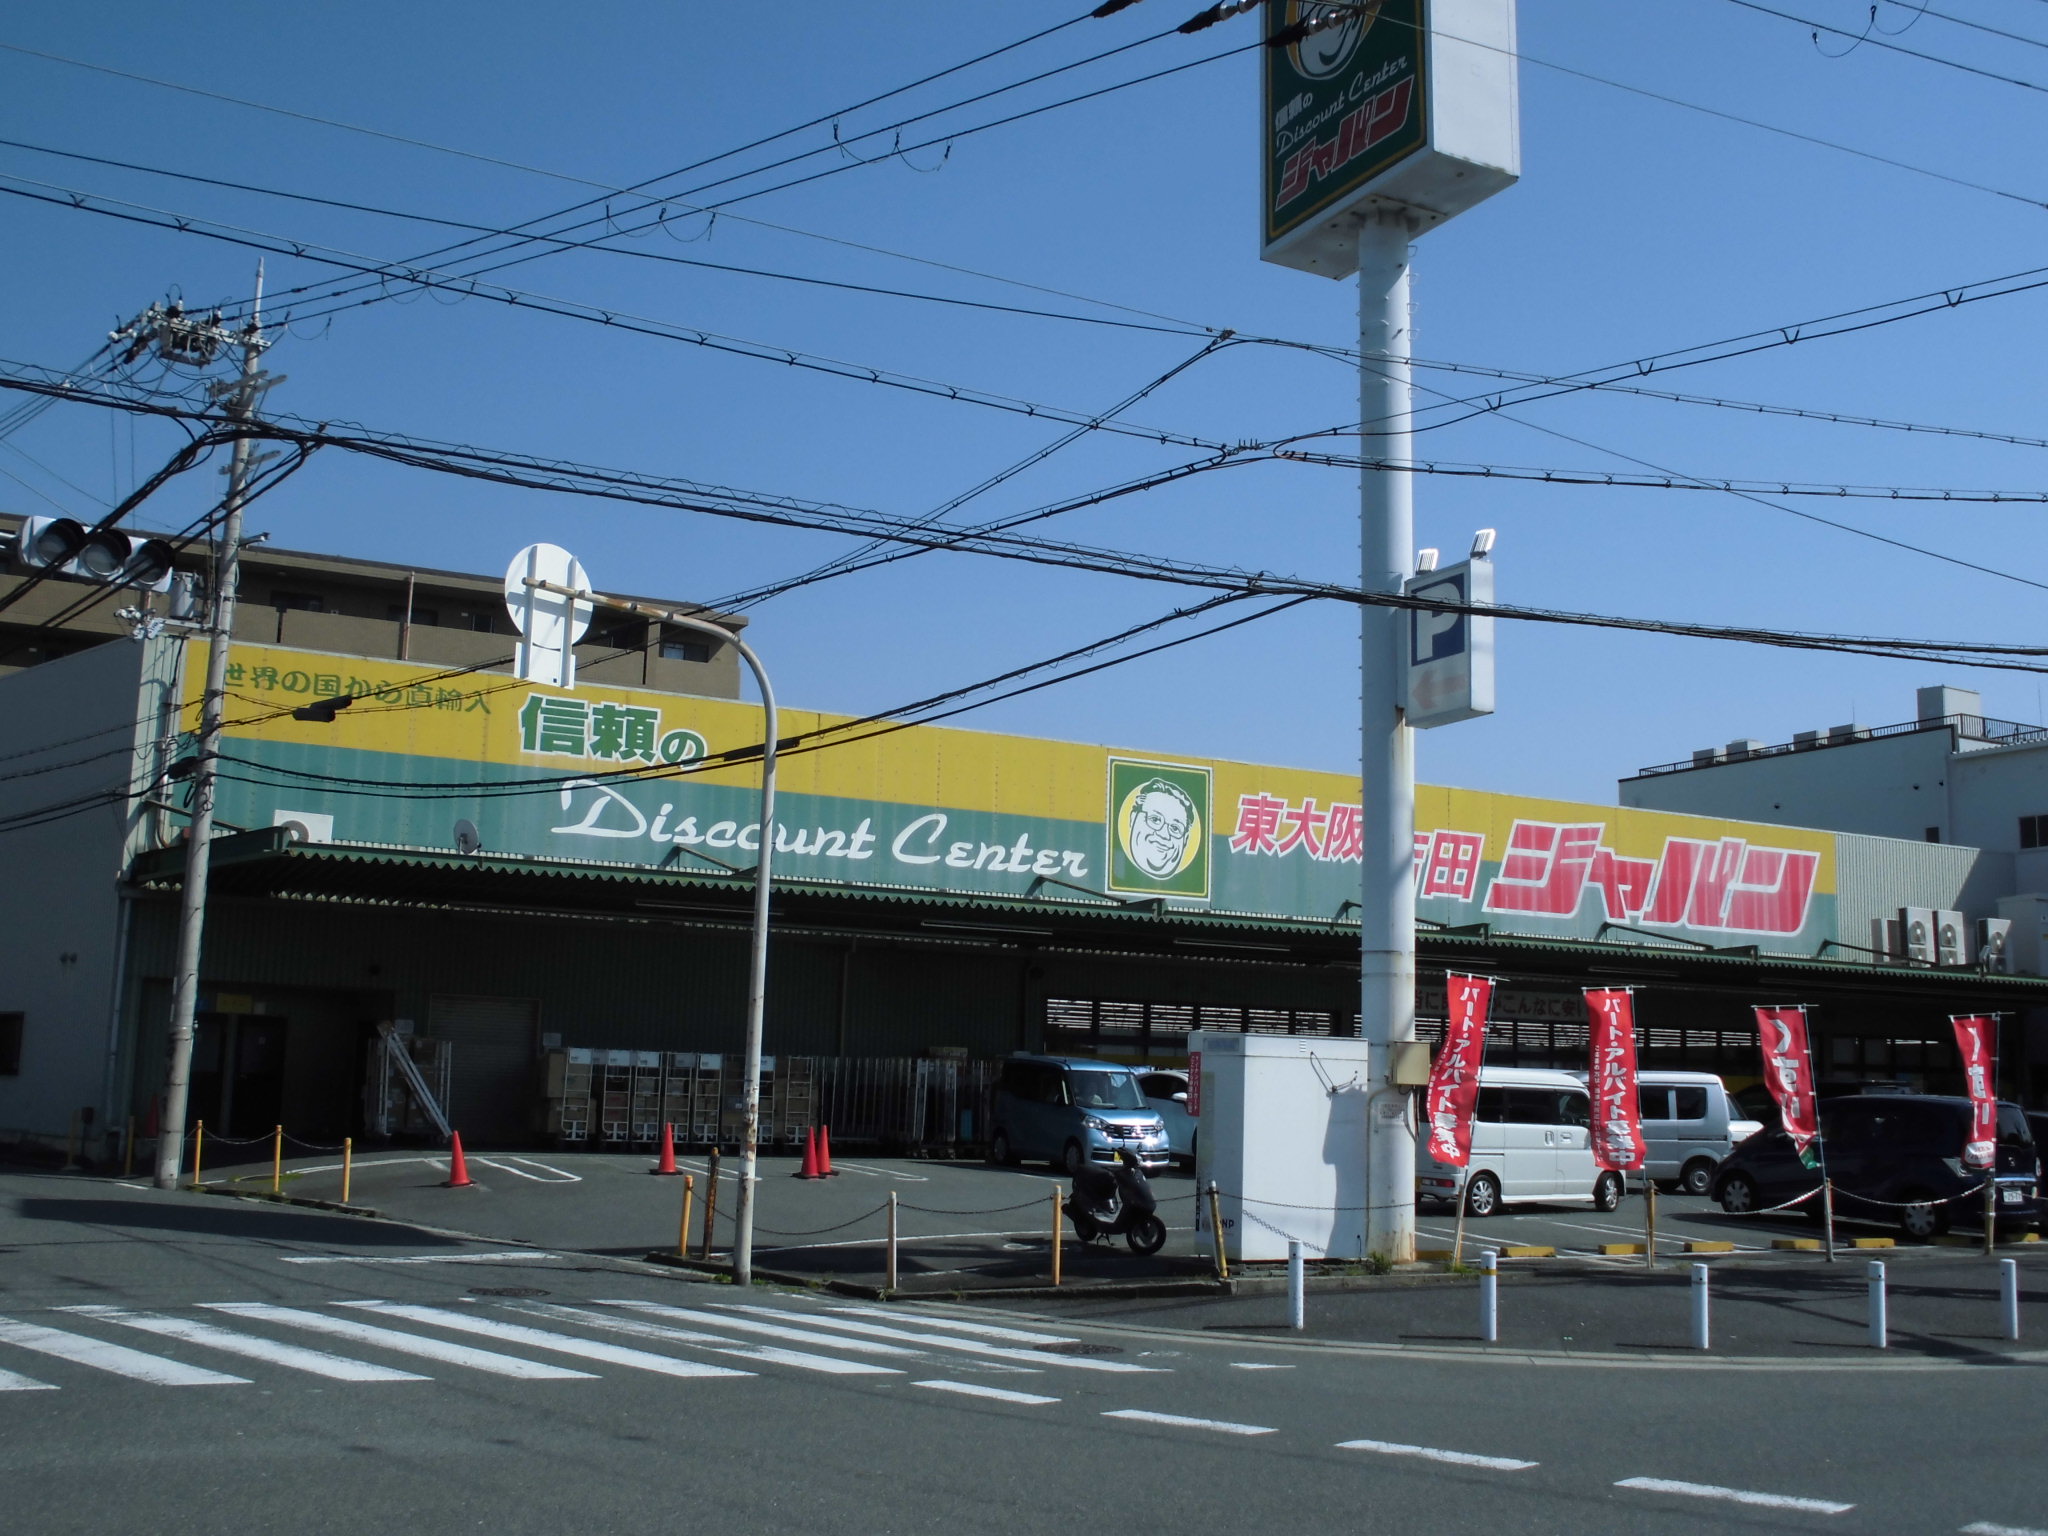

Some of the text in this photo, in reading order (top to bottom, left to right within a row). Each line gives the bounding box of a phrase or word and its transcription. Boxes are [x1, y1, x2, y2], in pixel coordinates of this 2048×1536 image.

[1275, 56, 1408, 158] Discount Center
[1275, 74, 1415, 211] ジャパン
[1416, 582, 1460, 661] P
[224, 662, 491, 715] 世界の国から直輸入
[518, 692, 708, 770] 信頼の
[551, 778, 1089, 879] Discount Center
[1481, 819, 1821, 937] ジャパン
